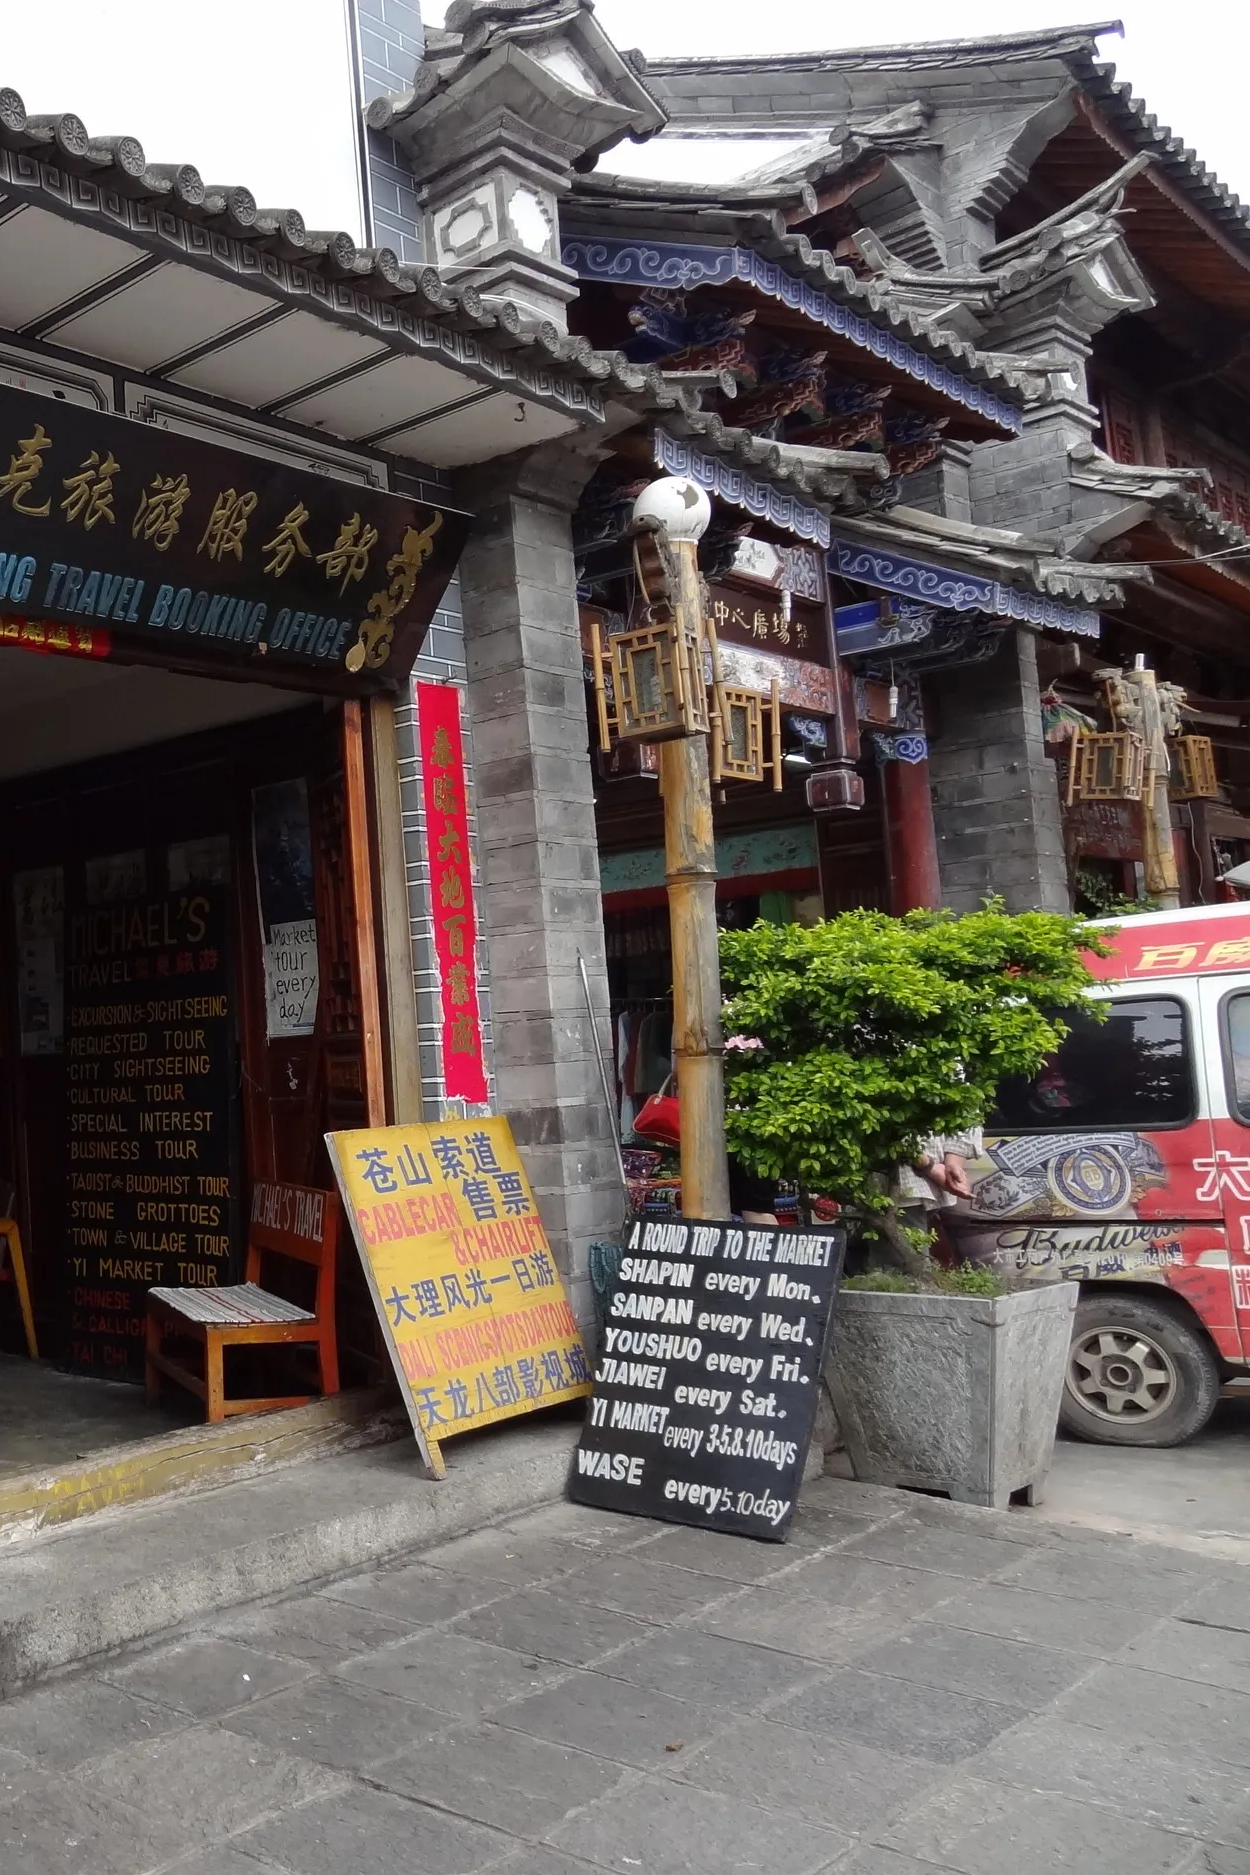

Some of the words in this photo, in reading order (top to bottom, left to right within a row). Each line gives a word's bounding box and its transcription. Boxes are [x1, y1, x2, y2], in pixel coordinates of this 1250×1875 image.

[43, 562, 145, 623] TRAVEL
[149, 584, 267, 645] BOOKING
[269, 607, 350, 660] OFFICE
[69, 897, 210, 960] MICHAEL'S
[272, 924, 316, 946] Market
[67, 961, 134, 992] TRAVEL
[275, 951, 308, 972] tour
[276, 975, 316, 999] every
[279, 998, 305, 1023] day
[70, 1034, 148, 1058] REQUESTED
[163, 1029, 207, 1052] TOUR
[70, 1062, 100, 1082] CITY
[113, 1055, 211, 1079] SIGHTSEEING
[70, 1085, 137, 1106] CULTURAL
[145, 1082, 186, 1103] TOUR
[70, 1113, 128, 1134] SPECIAL
[139, 1111, 214, 1133] INTEREST
[70, 1141, 140, 1161] BUSINESS
[154, 1140, 199, 1161] TOUR
[356, 1131, 502, 1195] 苍山索道
[197, 1175, 230, 1198] TOUR
[461, 1170, 532, 1222] 售票
[71, 1201, 115, 1220] STONE
[137, 1202, 222, 1227] GROTTOES
[293, 1189, 324, 1243] TRAVEL
[71, 1228, 108, 1248] TOWN
[129, 1231, 187, 1254] VILLAGE
[195, 1233, 230, 1257] TOUR
[628, 1221, 641, 1249] A
[641, 1222, 688, 1254] ROUND
[690, 1226, 719, 1256] TRIP
[722, 1229, 745, 1259] TO
[746, 1230, 773, 1261] THE
[774, 1232, 834, 1267] MARKET
[73, 1259, 87, 1277] YI
[99, 1258, 164, 1282] MARKET
[177, 1262, 218, 1286] TOUR
[385, 1250, 557, 1328] 大理风光一日游
[618, 1258, 694, 1288] SHAPIN
[704, 1271, 761, 1300] every
[767, 1273, 821, 1304] Mon.
[610, 1293, 693, 1325] SANPAN
[697, 1311, 753, 1340] every
[399, 1340, 439, 1382] DALI
[605, 1327, 702, 1362] YOUSHUO
[705, 1351, 763, 1384] every
[769, 1354, 810, 1384] Fri.
[415, 1342, 594, 1429] 天龙八部影视城
[594, 1357, 666, 1390] JIAWEI
[674, 1384, 732, 1414] every
[739, 1390, 787, 1419] Sat.
[590, 1397, 608, 1427] YI
[610, 1399, 670, 1434] MARKET
[663, 1424, 704, 1457] every
[577, 1449, 646, 1485] WASE
